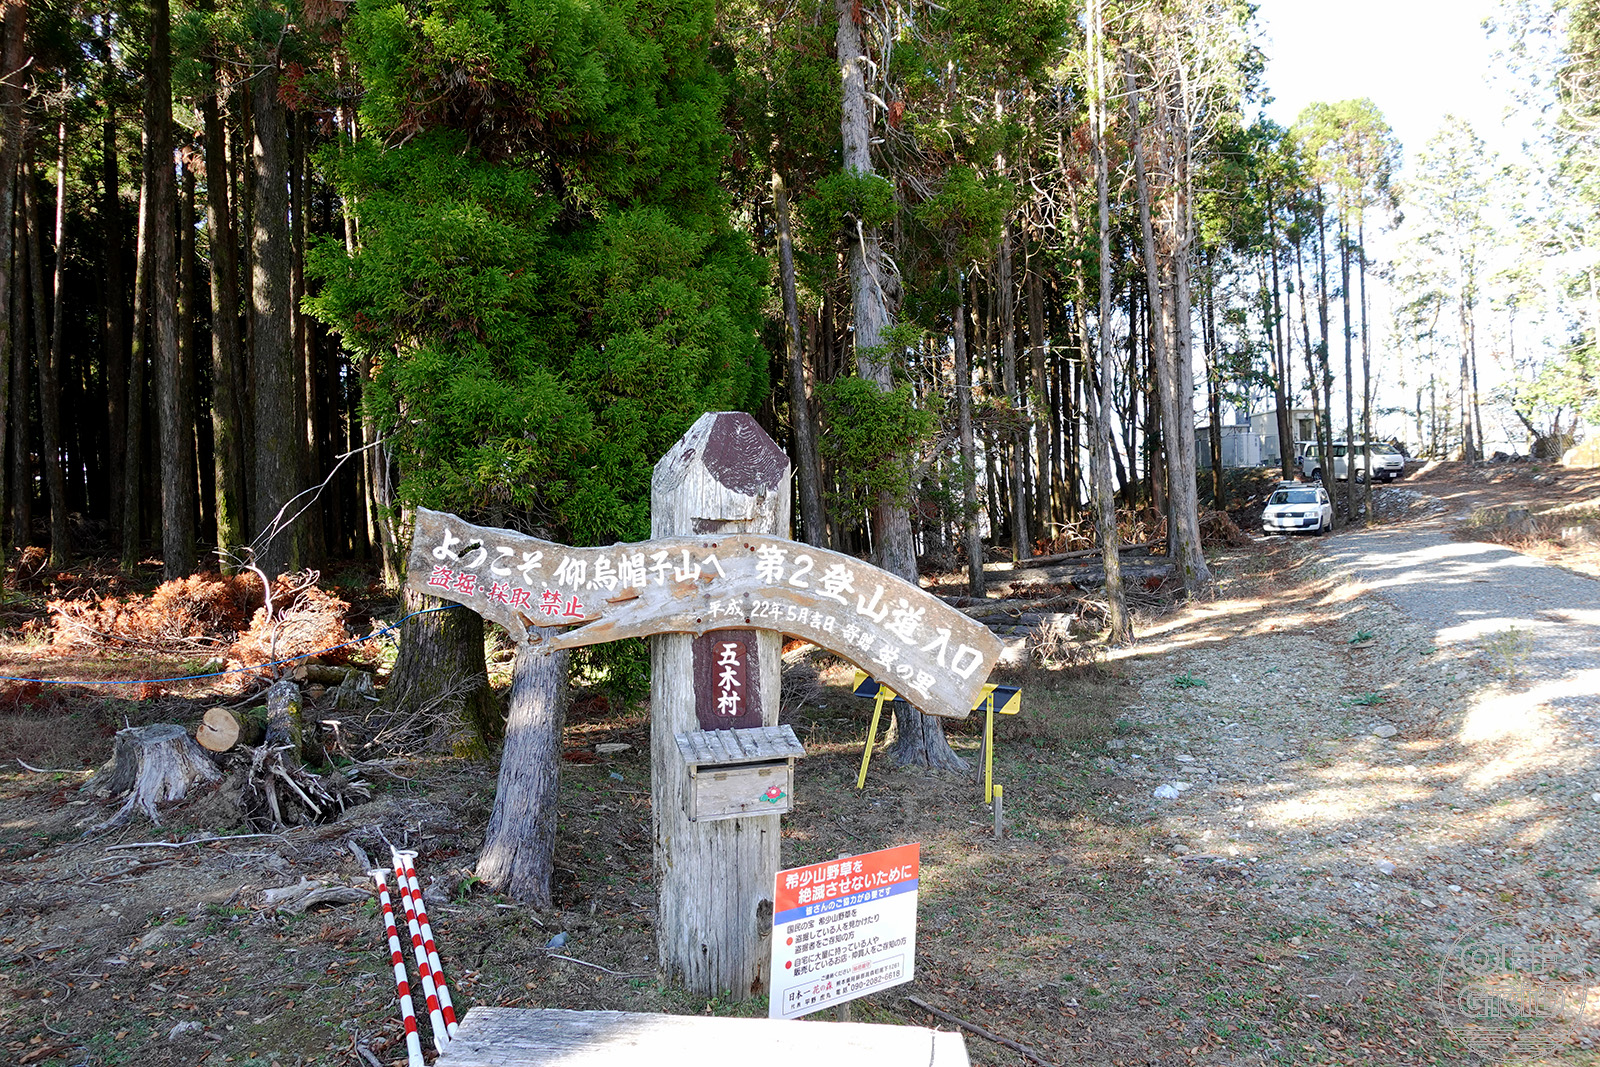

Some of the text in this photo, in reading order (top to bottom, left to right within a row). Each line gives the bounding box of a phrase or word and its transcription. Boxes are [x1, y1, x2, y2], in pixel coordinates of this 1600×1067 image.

[539, 589, 585, 619] 禁止
[717, 643, 741, 716] 五木村
[785, 860, 863, 890] 希少山野草を
[798, 864, 912, 905] 絶滅させないために
[805, 886, 892, 916] 皆さんのご協力が必要です
[786, 908, 858, 935] 国民の宝 希少山野草を
[795, 913, 880, 944] 盗掘している人を見かけたり
[793, 936, 880, 967] 自宅に大量に持っている人や
[794, 930, 855, 954] 盗掘者をご存知の方
